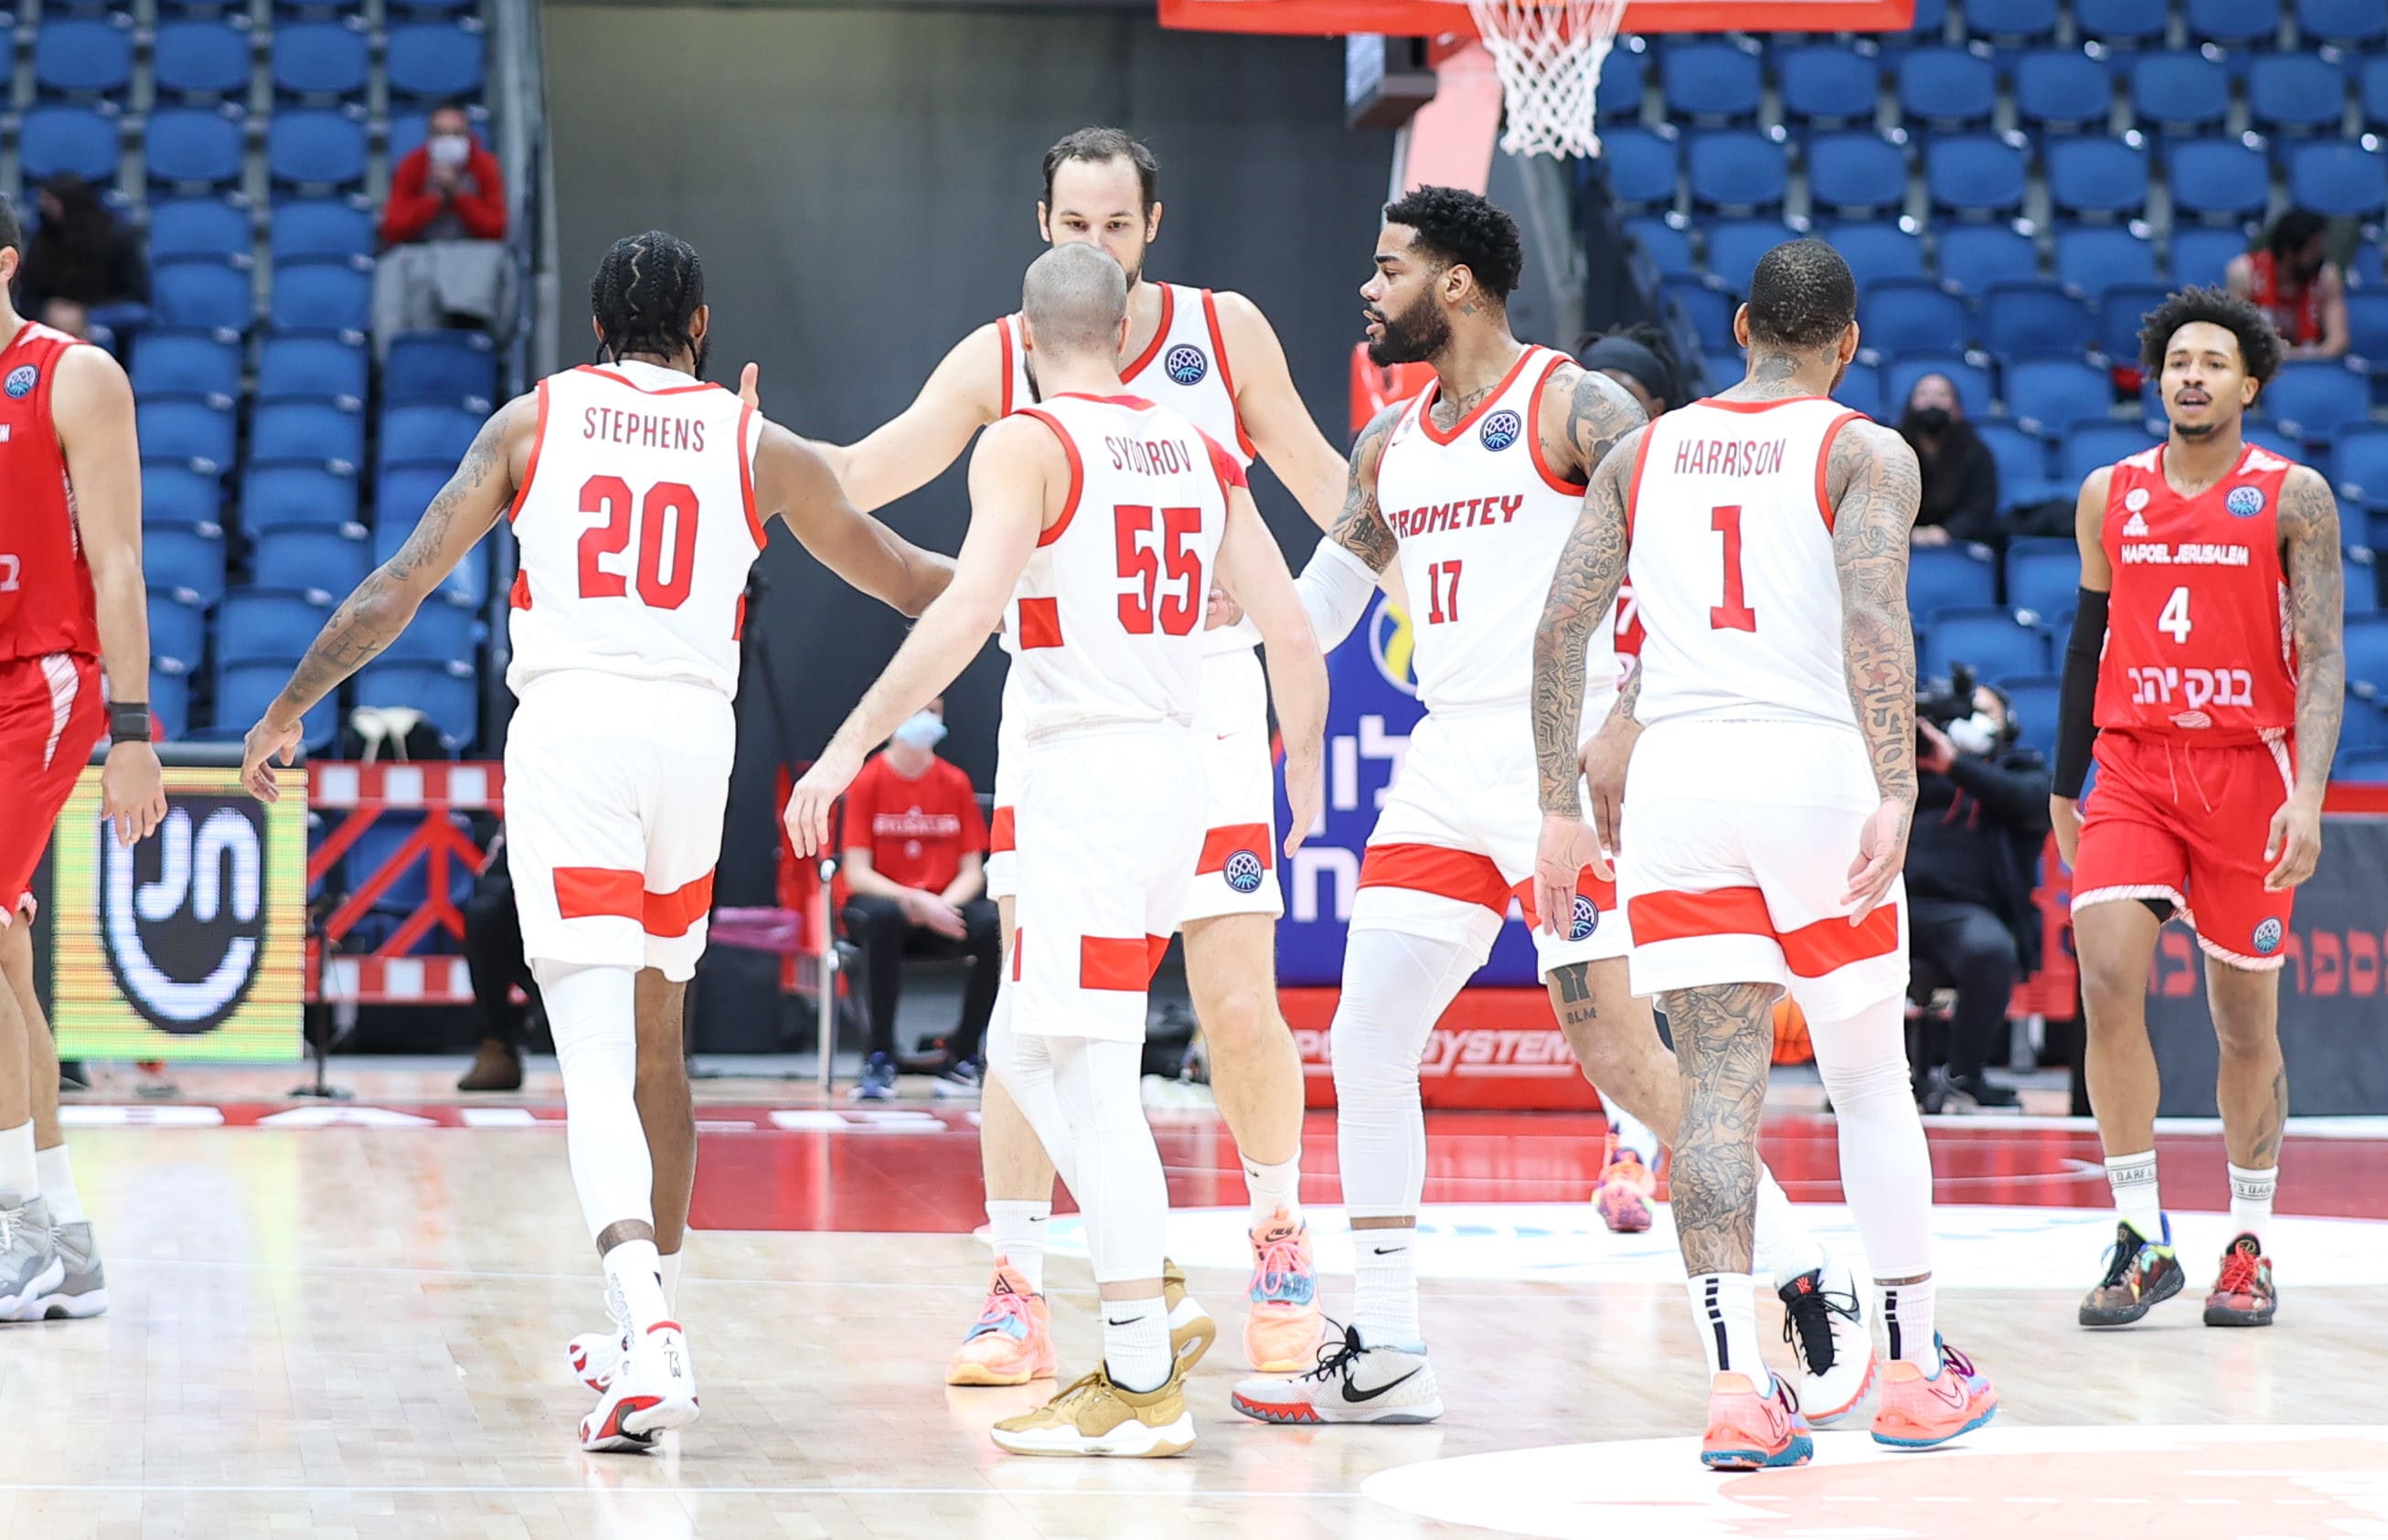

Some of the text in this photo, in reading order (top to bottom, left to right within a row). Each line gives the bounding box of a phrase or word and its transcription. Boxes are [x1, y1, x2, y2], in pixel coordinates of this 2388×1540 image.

[583, 407, 705, 452] STEPHENS
[1104, 435, 1192, 476] SYDOROV
[1674, 439, 1786, 477] HARRISON
[1388, 494, 1524, 539] PROMETEY
[578, 474, 699, 611] 20
[2121, 543, 2250, 567] HAPOEL JERUSALEM
[1114, 504, 1202, 636] 55
[1711, 504, 1756, 632] 1
[1428, 559, 1463, 624] 17
[2158, 586, 2192, 643] 4
[2184, 668, 2254, 709] בנק
